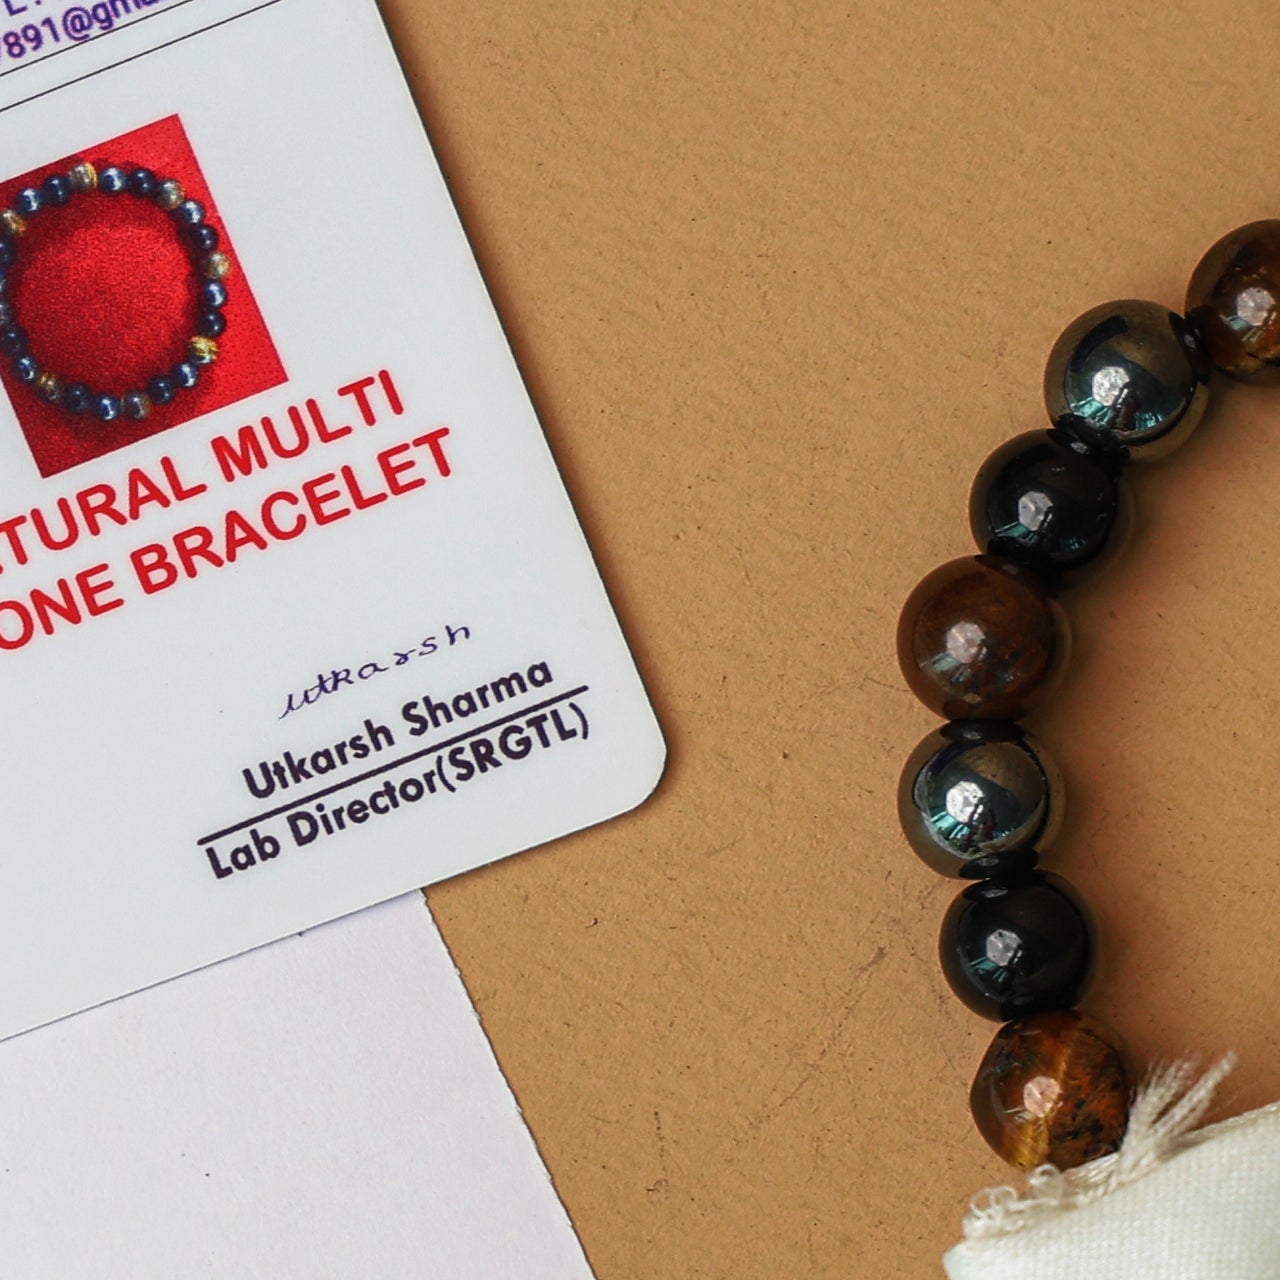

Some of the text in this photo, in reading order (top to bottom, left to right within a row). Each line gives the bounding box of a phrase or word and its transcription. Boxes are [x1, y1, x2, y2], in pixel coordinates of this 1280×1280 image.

[210, 369, 404, 483] MULTI
[129, 426, 452, 595] BRACELET
[205, 701, 589, 880] Lab Director(SRGTL)
[242, 661, 554, 800] Utkarsh Sharma
